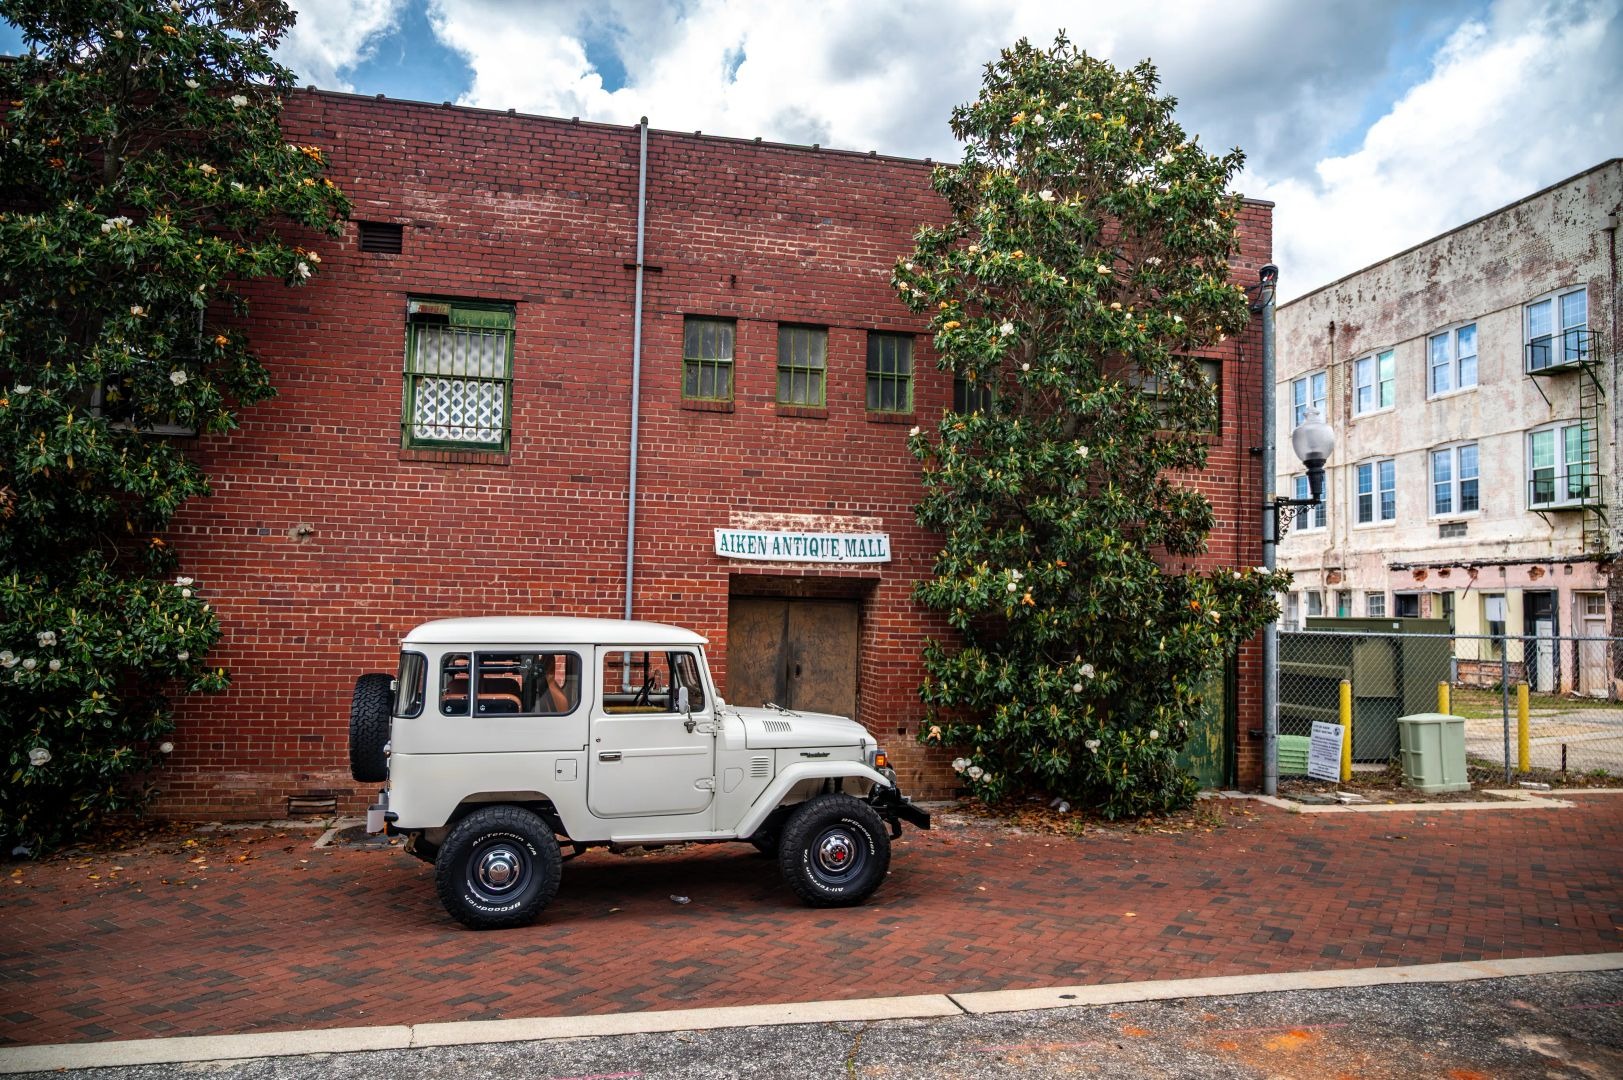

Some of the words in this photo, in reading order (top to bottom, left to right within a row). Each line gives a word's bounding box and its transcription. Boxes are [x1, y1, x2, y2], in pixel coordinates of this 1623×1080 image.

[720, 533, 767, 555] AIKEN
[772, 536, 840, 559] ANTIQUE
[845, 538, 886, 558] MALL
[472, 832, 524, 847] All-Terrain
[464, 894, 521, 912] BFGoodrich
